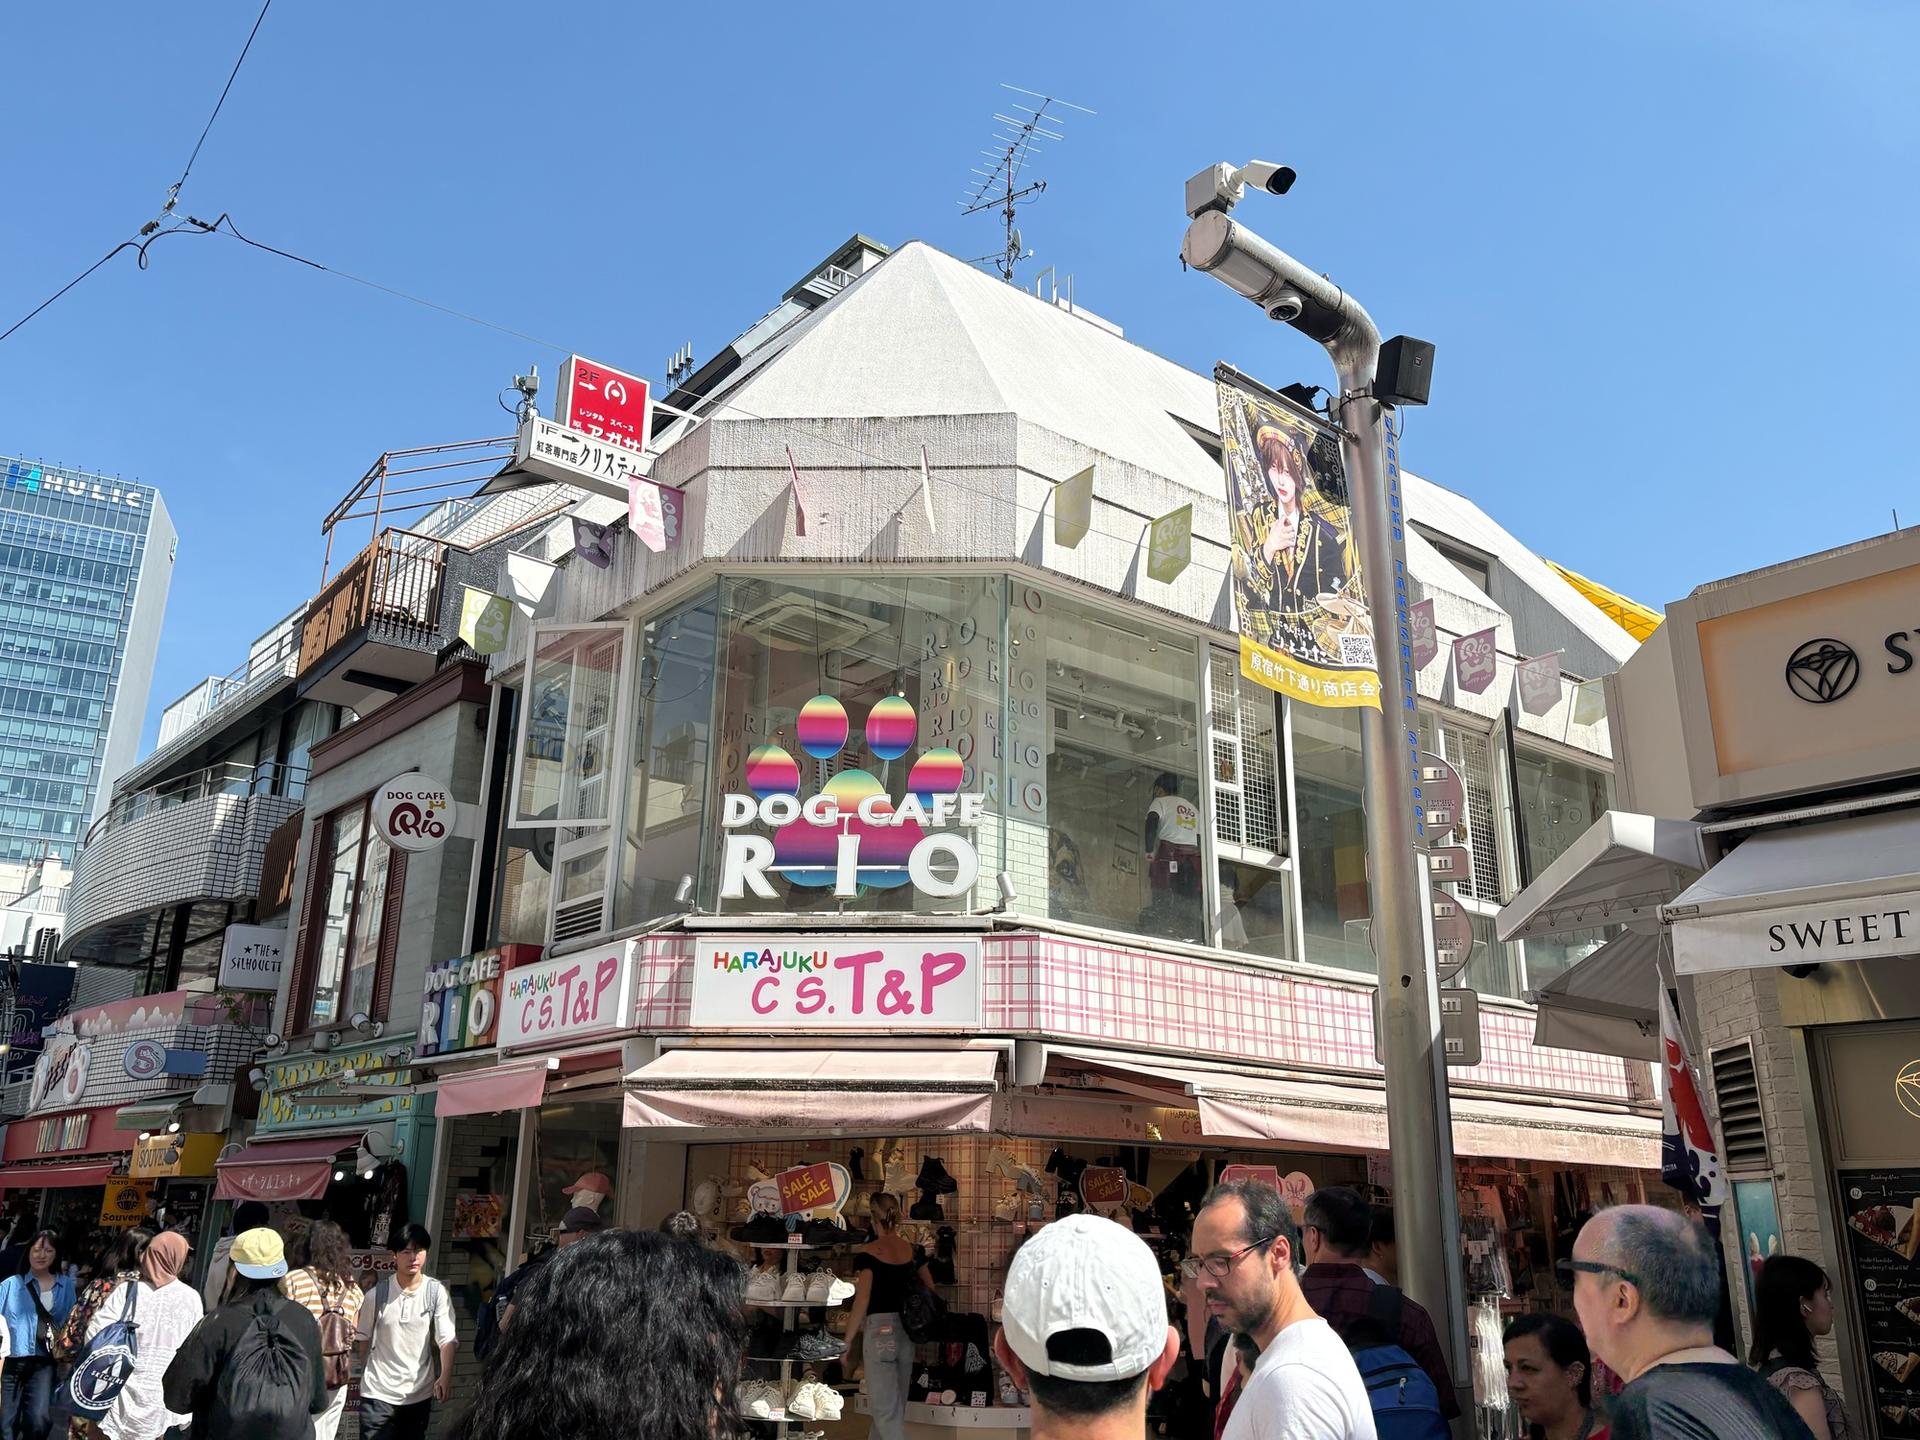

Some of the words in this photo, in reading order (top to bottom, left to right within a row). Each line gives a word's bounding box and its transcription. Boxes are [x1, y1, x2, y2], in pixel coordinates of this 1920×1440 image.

[578, 367, 600, 383] 2F
[540, 423, 559, 436] 1F
[579, 407, 605, 422] レンタル
[610, 418, 635, 433] スペース
[536, 440, 578, 465] 紅茶専門店
[43, 473, 142, 508] HULIC
[1395, 559, 1415, 711] TAKESHITA
[1460, 636, 1491, 662] Rio
[1884, 627, 1920, 675] S
[1250, 651, 1377, 697] 原宿竹下通り商店会
[387, 791, 414, 801] DOG
[417, 791, 446, 801] CAFE
[721, 793, 840, 828] DOG
[857, 792, 987, 828] CAFE
[388, 802, 446, 839] Rio
[720, 832, 980, 900] RIO
[1767, 909, 1911, 954] SWEET
[253, 943, 271, 957] THE
[713, 947, 829, 975] HARAJUKU
[423, 963, 460, 996] DOG
[459, 953, 501, 986] CAFE
[509, 969, 557, 1001] HARAJUKU
[833, 950, 967, 1016] T&P
[557, 956, 619, 1027] T&P
[420, 988, 496, 1047] RIO
[782, 1172, 813, 1199] SALE
[799, 1179, 830, 1206] SALE
[1087, 1173, 1111, 1190] SALE
[1098, 1180, 1122, 1198] SALE
